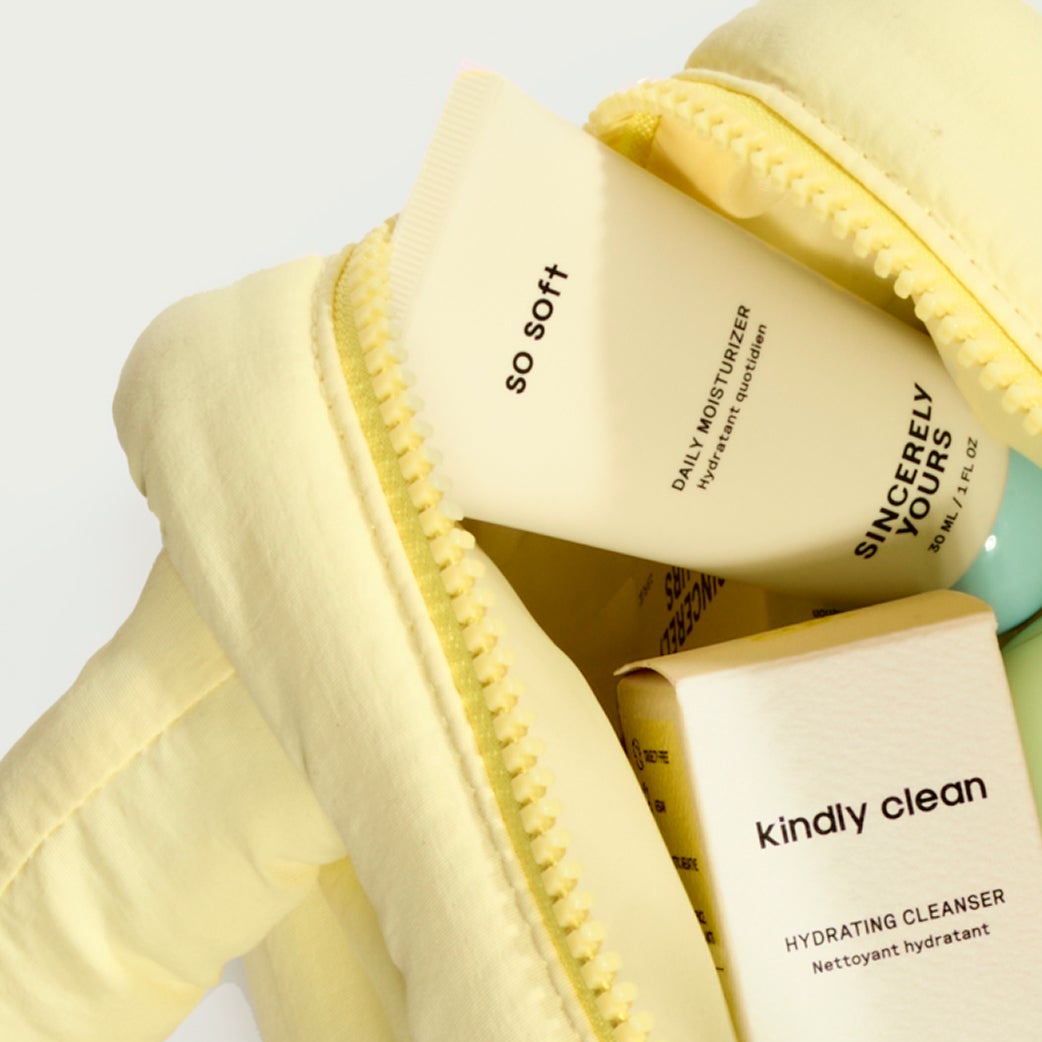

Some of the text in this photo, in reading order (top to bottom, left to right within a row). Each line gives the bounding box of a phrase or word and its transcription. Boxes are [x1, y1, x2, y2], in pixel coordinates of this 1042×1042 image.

[671, 303, 752, 493] DAILY MOISTURIZER
[696, 324, 767, 490] Hydratant quotidien
[854, 382, 933, 560] SINCERELY
[960, 464, 976, 483] FL
[966, 436, 978, 459] OZ
[895, 428, 952, 537] YOURS
[957, 486, 968, 495] 1
[927, 534, 946, 554] 30
[940, 512, 959, 533] ML
[659, 573, 726, 657] INCEREL
[755, 777, 988, 849] kindly clean
[785, 888, 1006, 952] HYDRATING CLEANSER
[812, 923, 991, 975] Nettoyant hydratant
